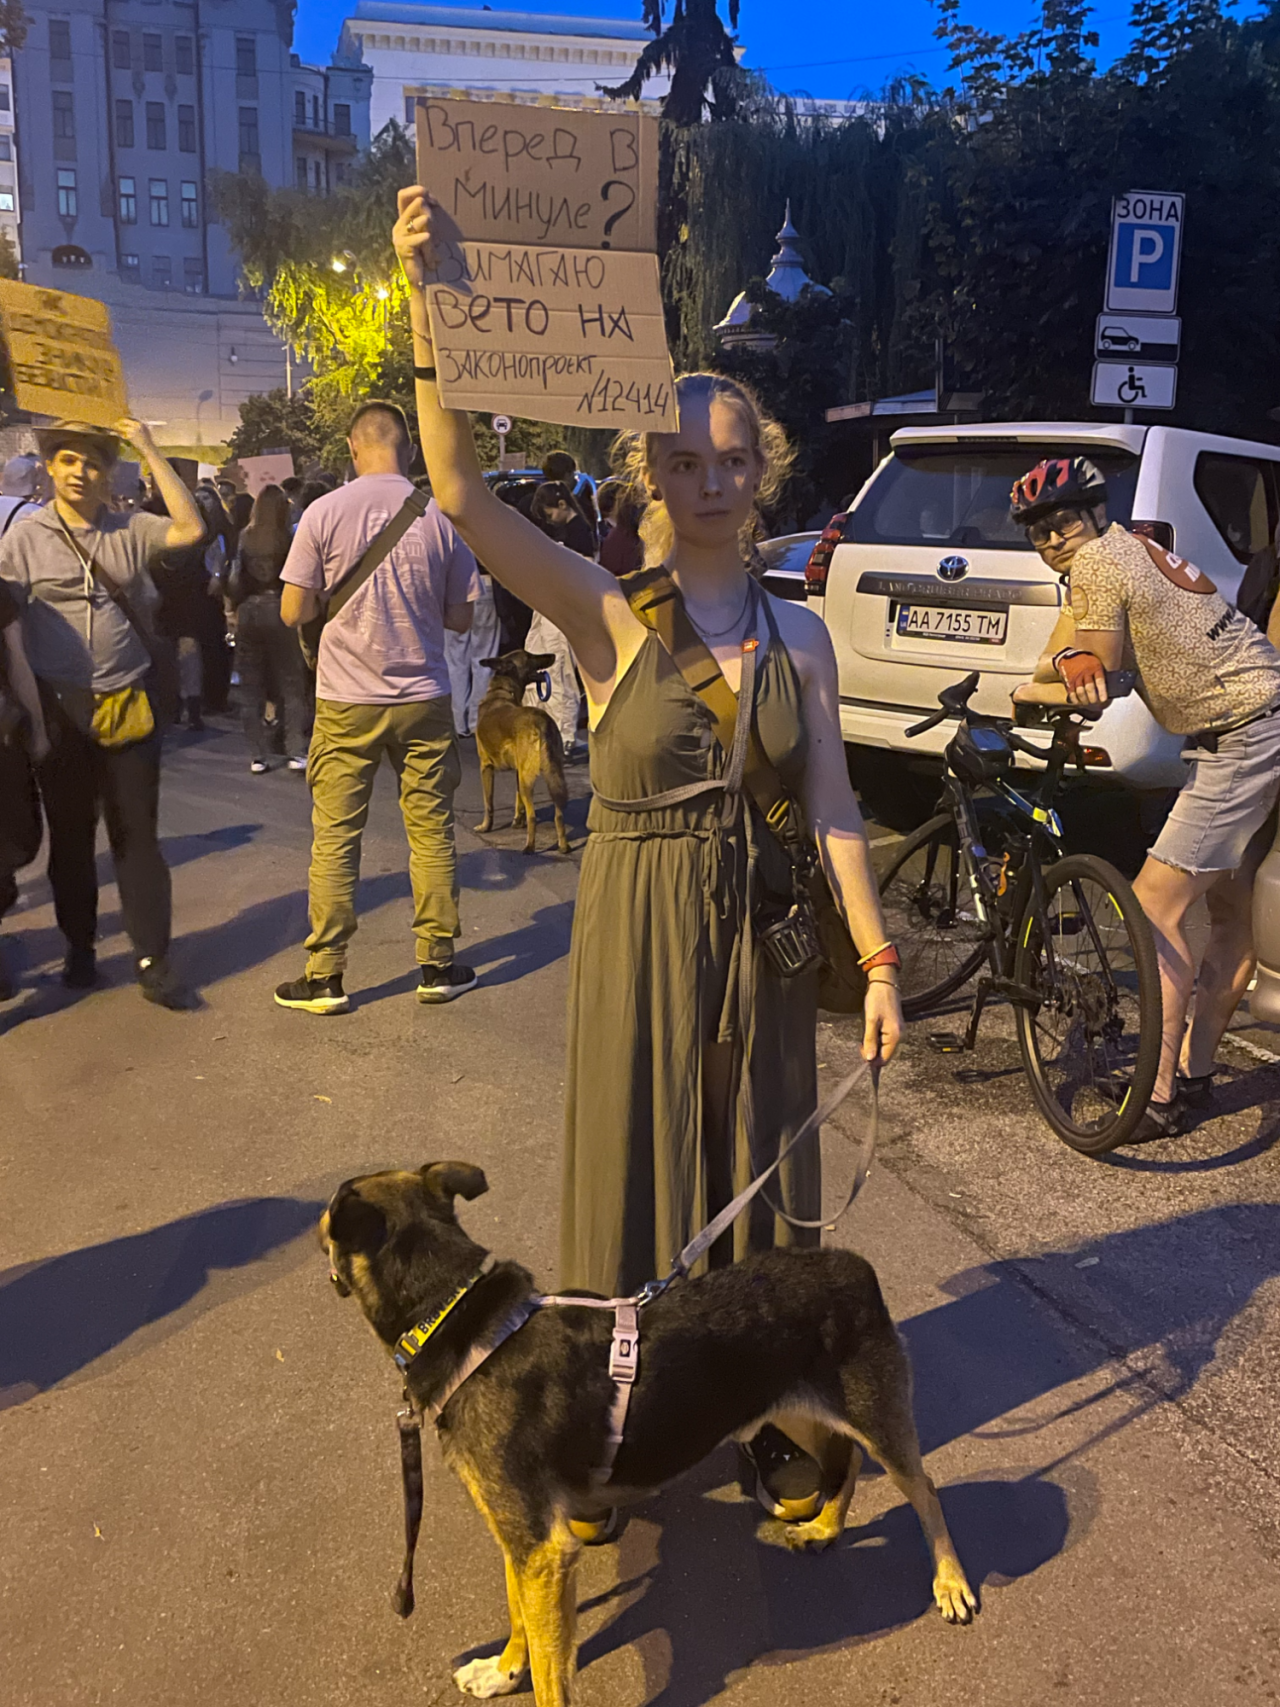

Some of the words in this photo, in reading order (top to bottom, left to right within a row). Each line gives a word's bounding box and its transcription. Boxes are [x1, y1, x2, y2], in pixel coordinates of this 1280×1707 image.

[425, 105, 581, 172] Вперед
[1117, 198, 1180, 222] ЗОНА
[1130, 229, 1164, 283] P
[578, 303, 634, 342] НА
[908, 610, 929, 630] AA
[935, 612, 971, 632] 7155
[977, 615, 1001, 636] TM
